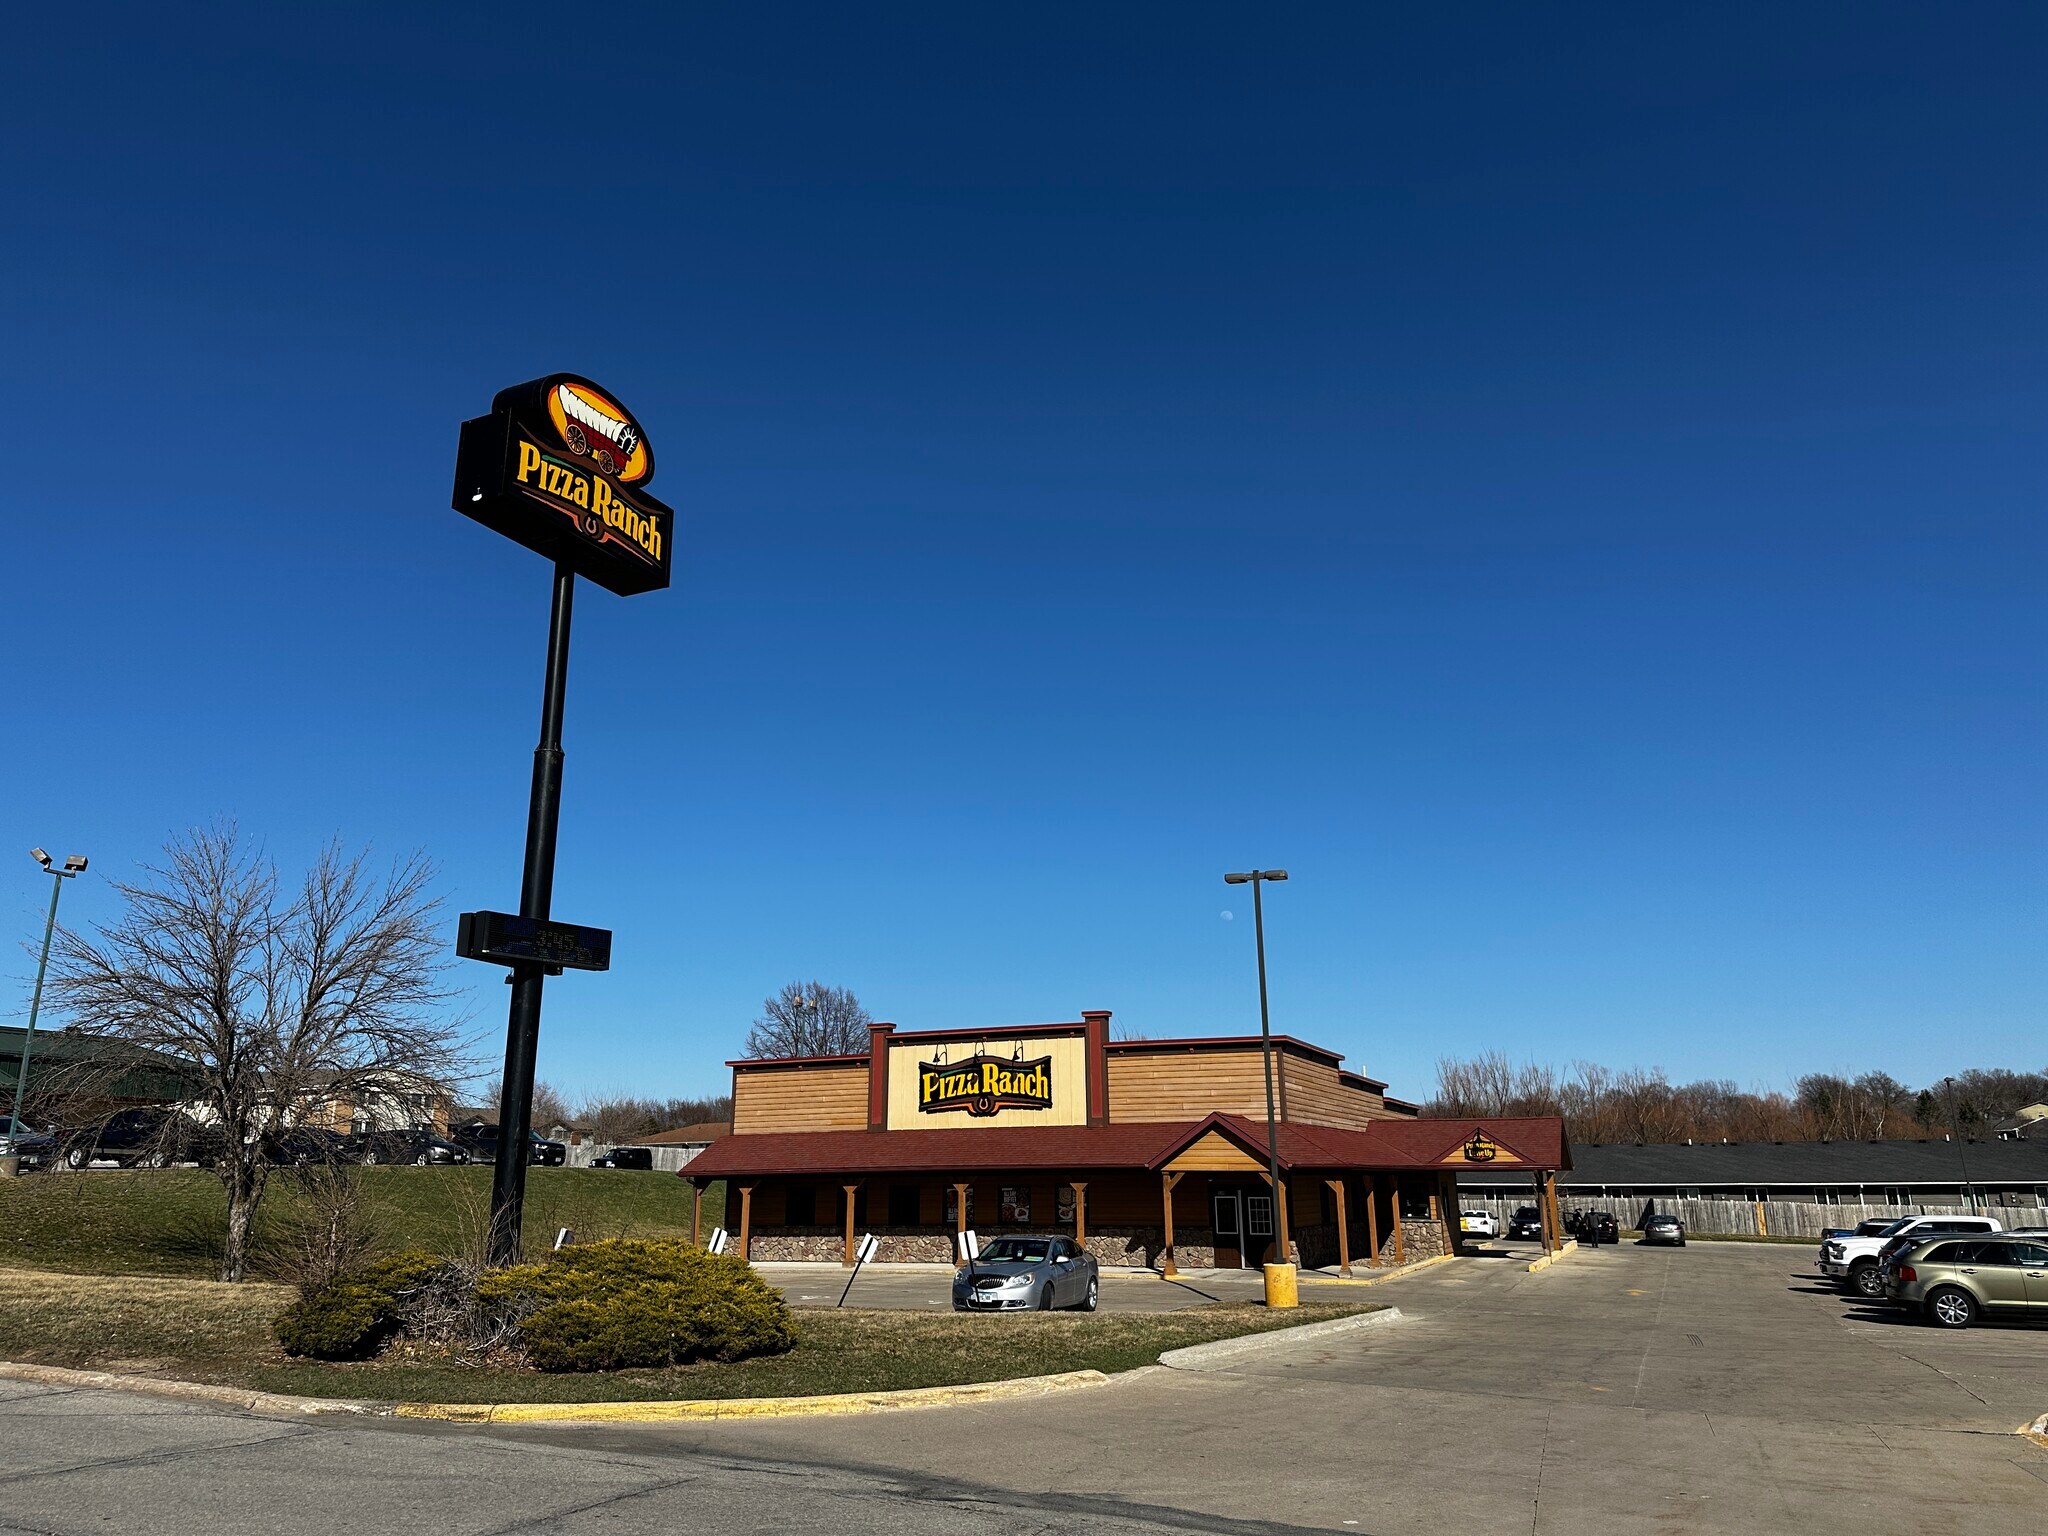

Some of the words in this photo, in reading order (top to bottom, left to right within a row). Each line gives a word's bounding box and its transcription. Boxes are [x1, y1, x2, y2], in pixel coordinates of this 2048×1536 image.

[516, 440, 589, 509] Pizza
[591, 474, 661, 561] Ranch
[922, 1072, 980, 1103] Pizza
[981, 1063, 1049, 1099] Ranch
